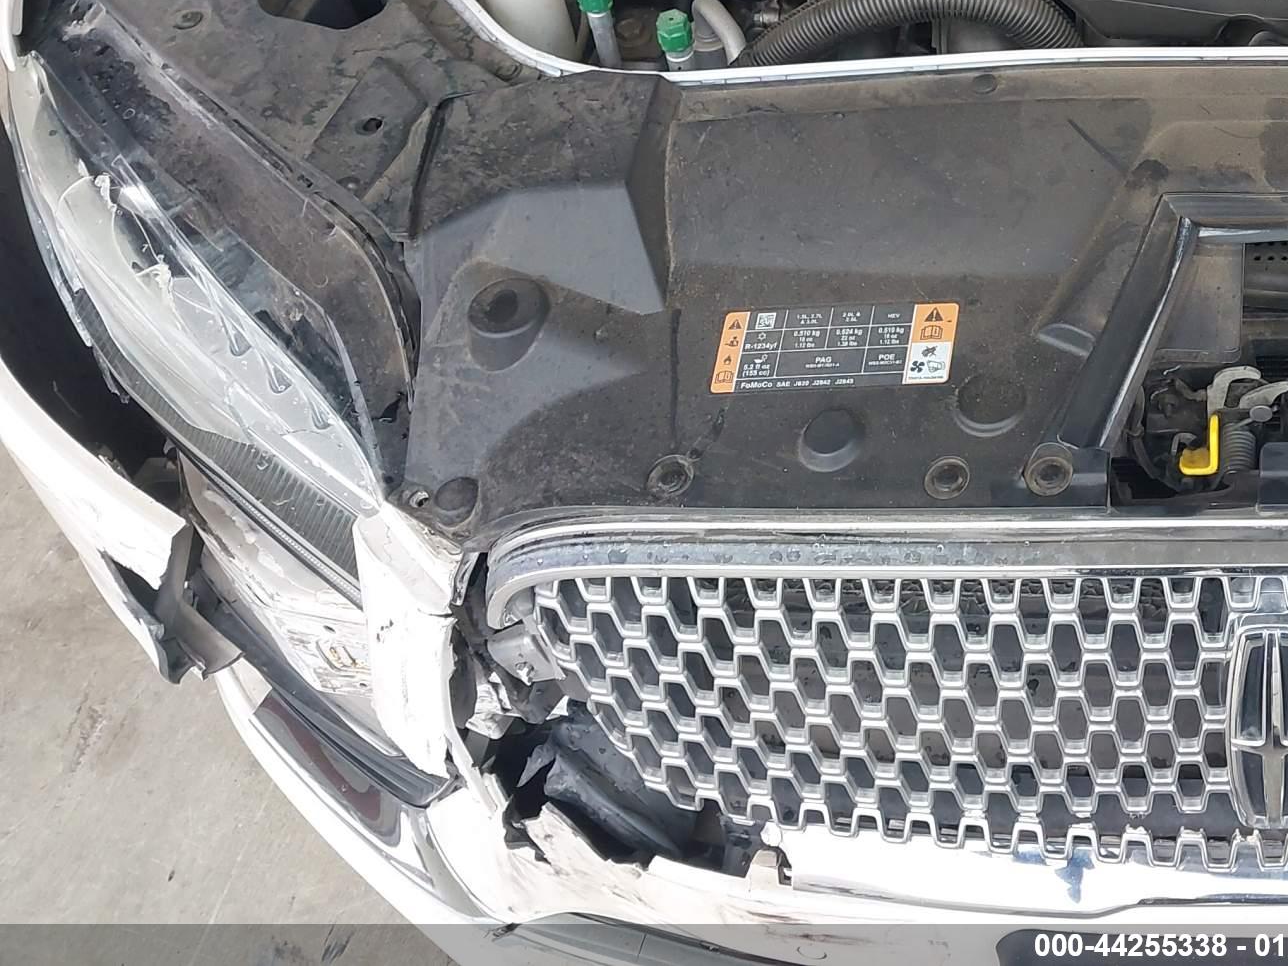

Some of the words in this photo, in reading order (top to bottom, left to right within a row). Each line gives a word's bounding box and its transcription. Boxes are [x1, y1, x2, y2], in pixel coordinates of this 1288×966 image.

[896, 326, 905, 334] kg
[744, 342, 778, 350] R-1234yf
[878, 353, 896, 361] POE
[741, 381, 773, 389] FoMoCo
